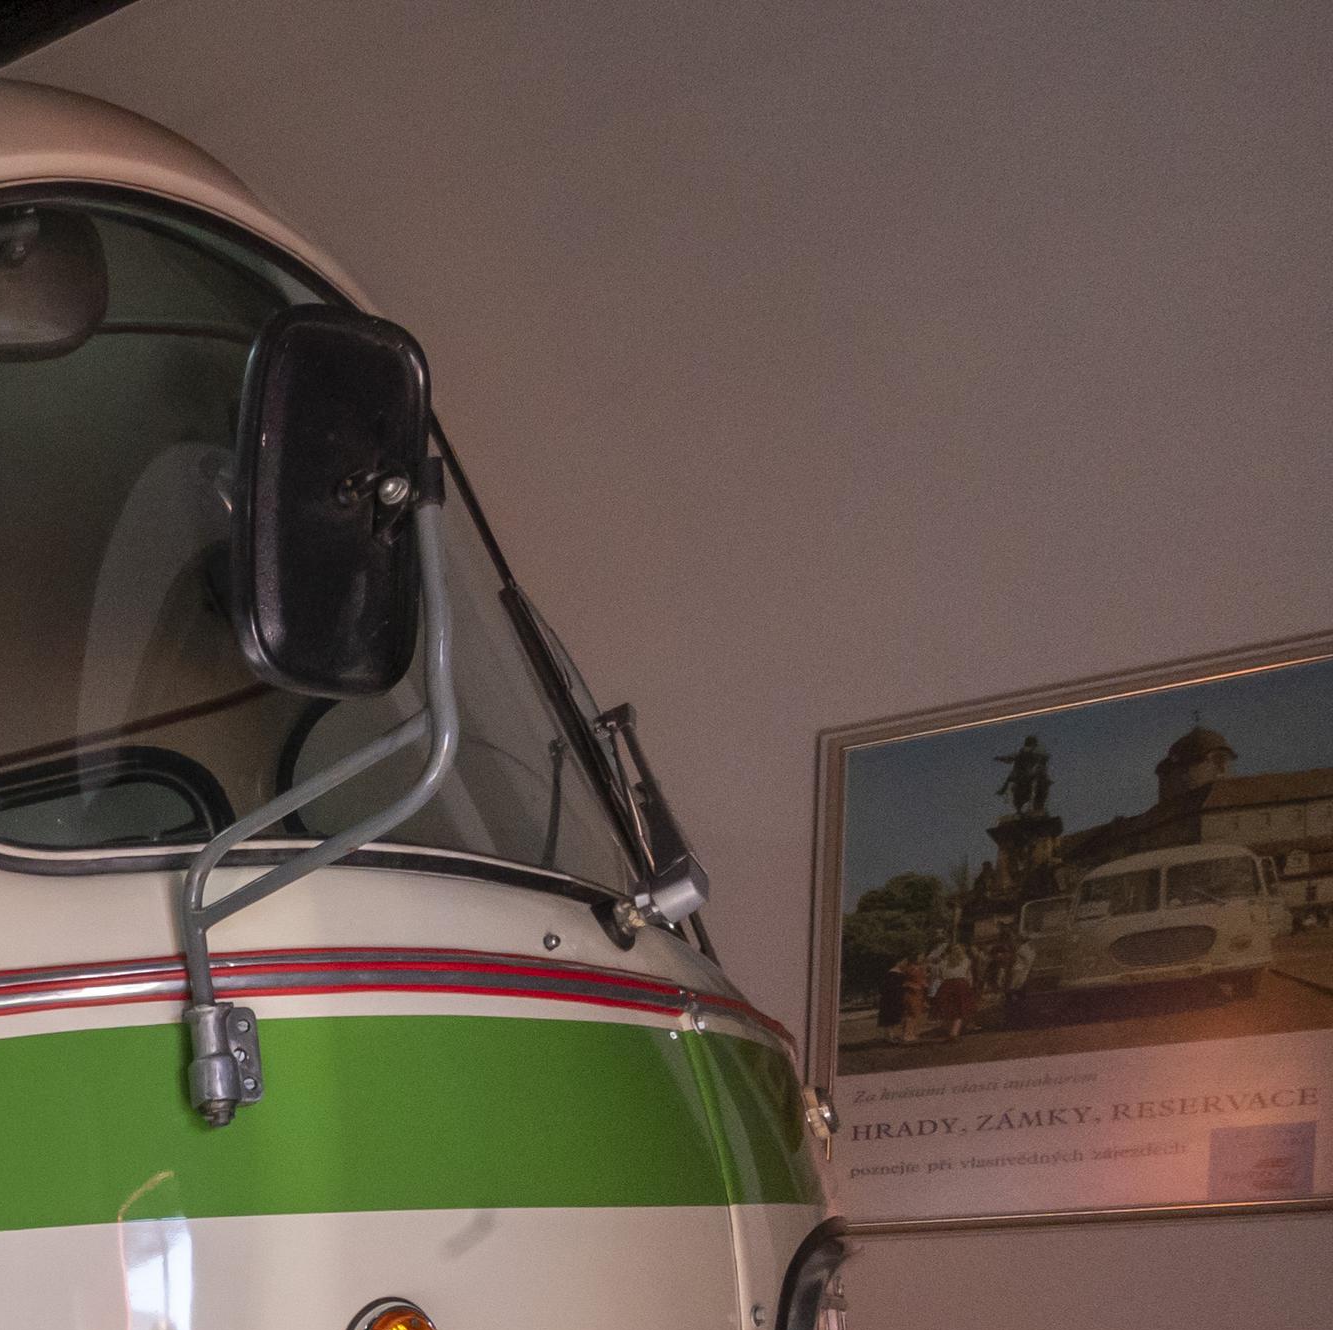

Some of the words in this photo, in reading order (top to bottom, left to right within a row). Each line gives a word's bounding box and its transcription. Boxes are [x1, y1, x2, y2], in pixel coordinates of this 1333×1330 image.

[851, 1116, 968, 1142] HRADY,
[976, 1106, 1102, 1133] ZÁMKY,
[1111, 1087, 1319, 1122] RESERVACE
[849, 1160, 920, 1179] poznejte
[927, 1157, 952, 1174] při
[959, 1148, 1083, 1170] vlastivědných
